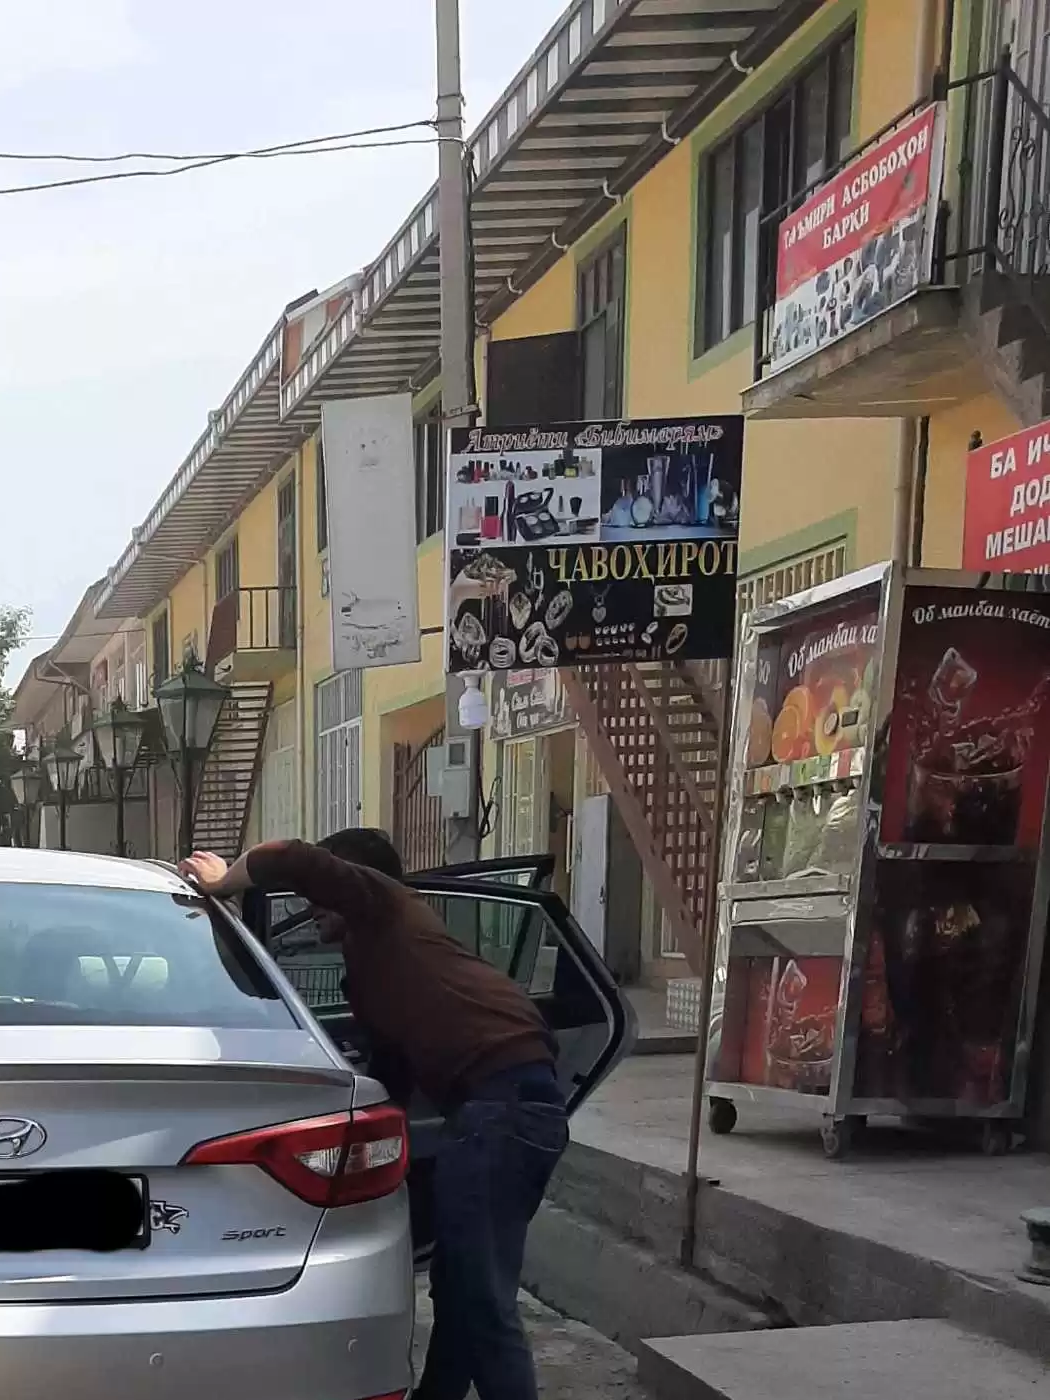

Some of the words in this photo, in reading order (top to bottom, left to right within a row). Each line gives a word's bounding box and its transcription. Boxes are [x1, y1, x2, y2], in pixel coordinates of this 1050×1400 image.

[990, 447, 1017, 479] БА
[985, 515, 1050, 560] МЕША
[912, 604, 936, 624] Об
[221, 1225, 286, 1241] Sport
